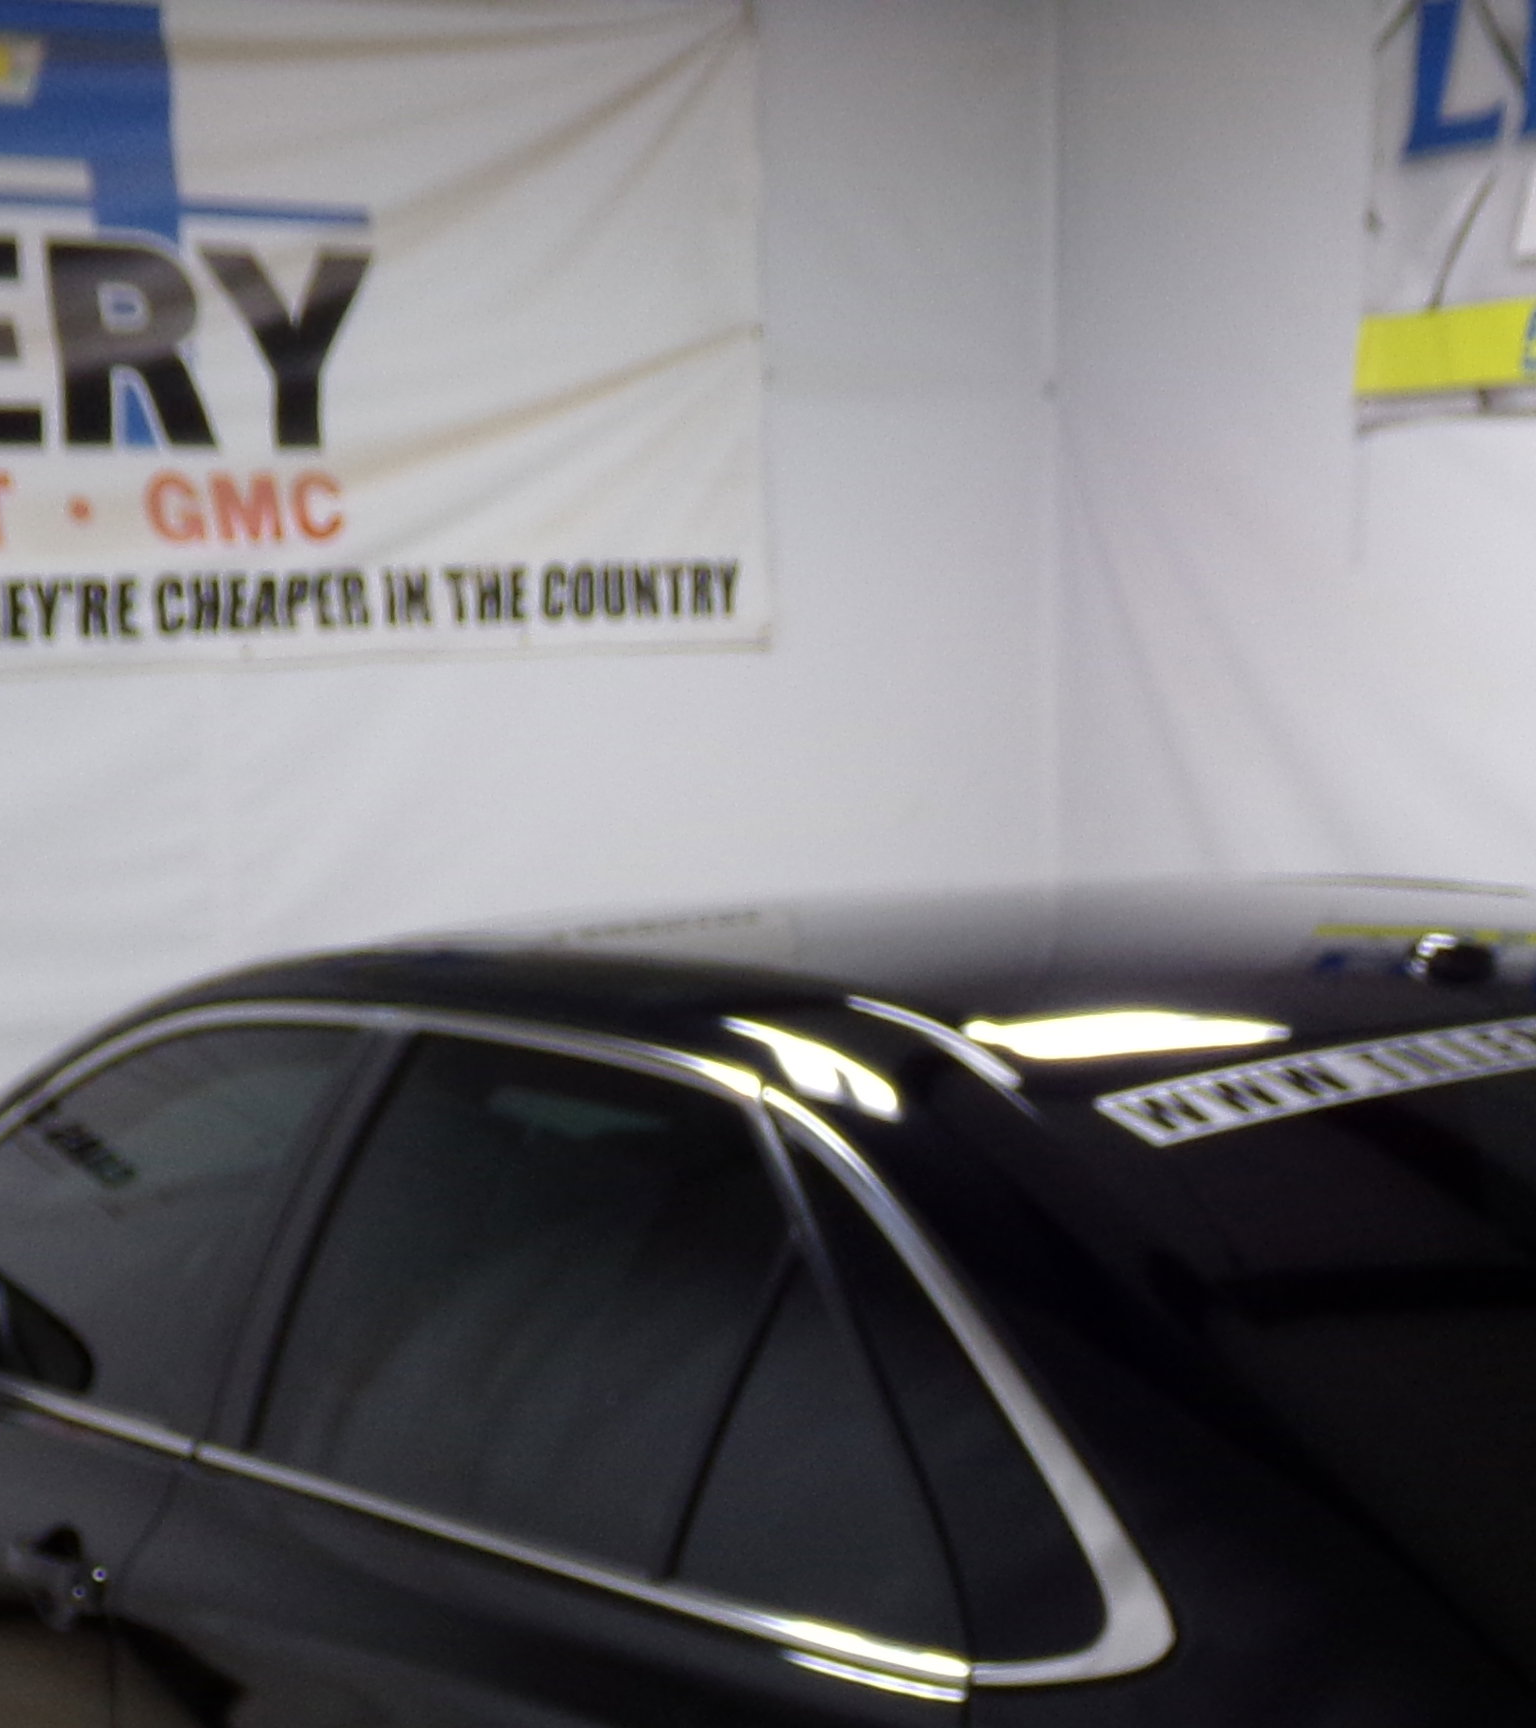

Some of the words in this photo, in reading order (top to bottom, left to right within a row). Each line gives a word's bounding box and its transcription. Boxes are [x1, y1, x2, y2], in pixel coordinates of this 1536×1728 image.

[145, 470, 345, 544] GMC
[153, 566, 370, 638] CHEAPER
[381, 564, 434, 628] IN
[443, 564, 528, 628] THE
[541, 556, 740, 622] COUNTRY
